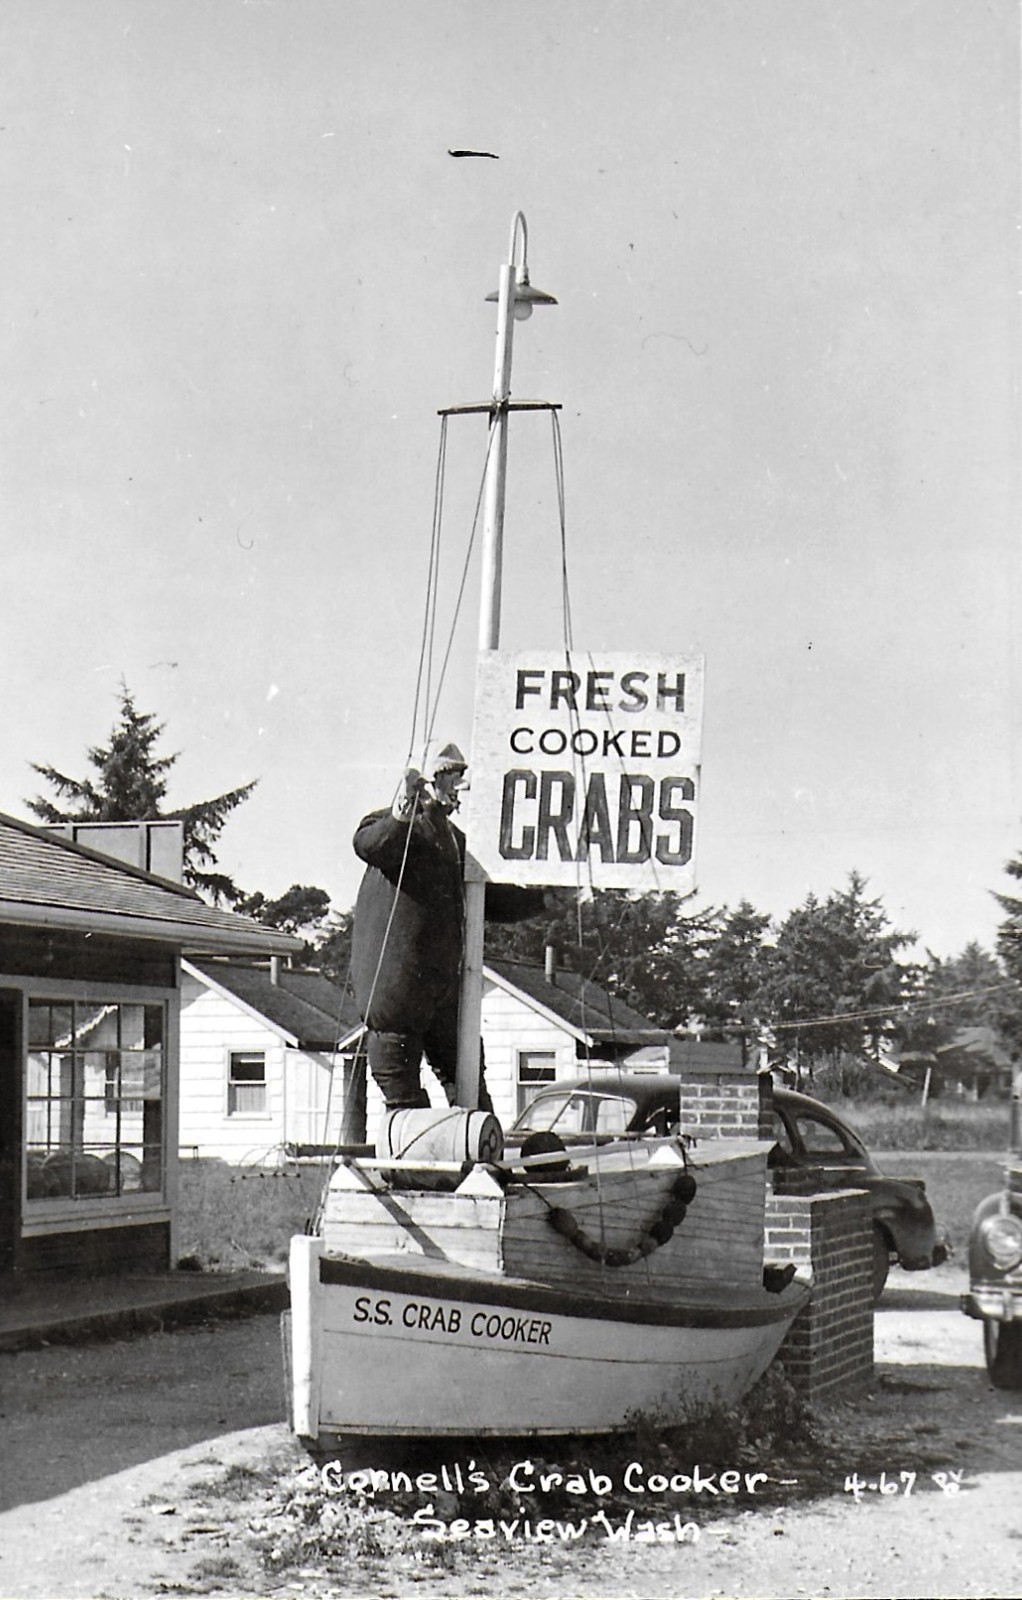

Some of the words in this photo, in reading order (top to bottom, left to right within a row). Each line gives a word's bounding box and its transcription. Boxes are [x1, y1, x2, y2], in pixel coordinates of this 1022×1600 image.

[515, 669, 686, 713] FRESH
[510, 727, 681, 758] COOKED
[498, 768, 695, 866] CRABS
[353, 1297, 393, 1326] S.S.
[402, 1303, 462, 1333] CRAB
[470, 1312, 552, 1345] COOKER
